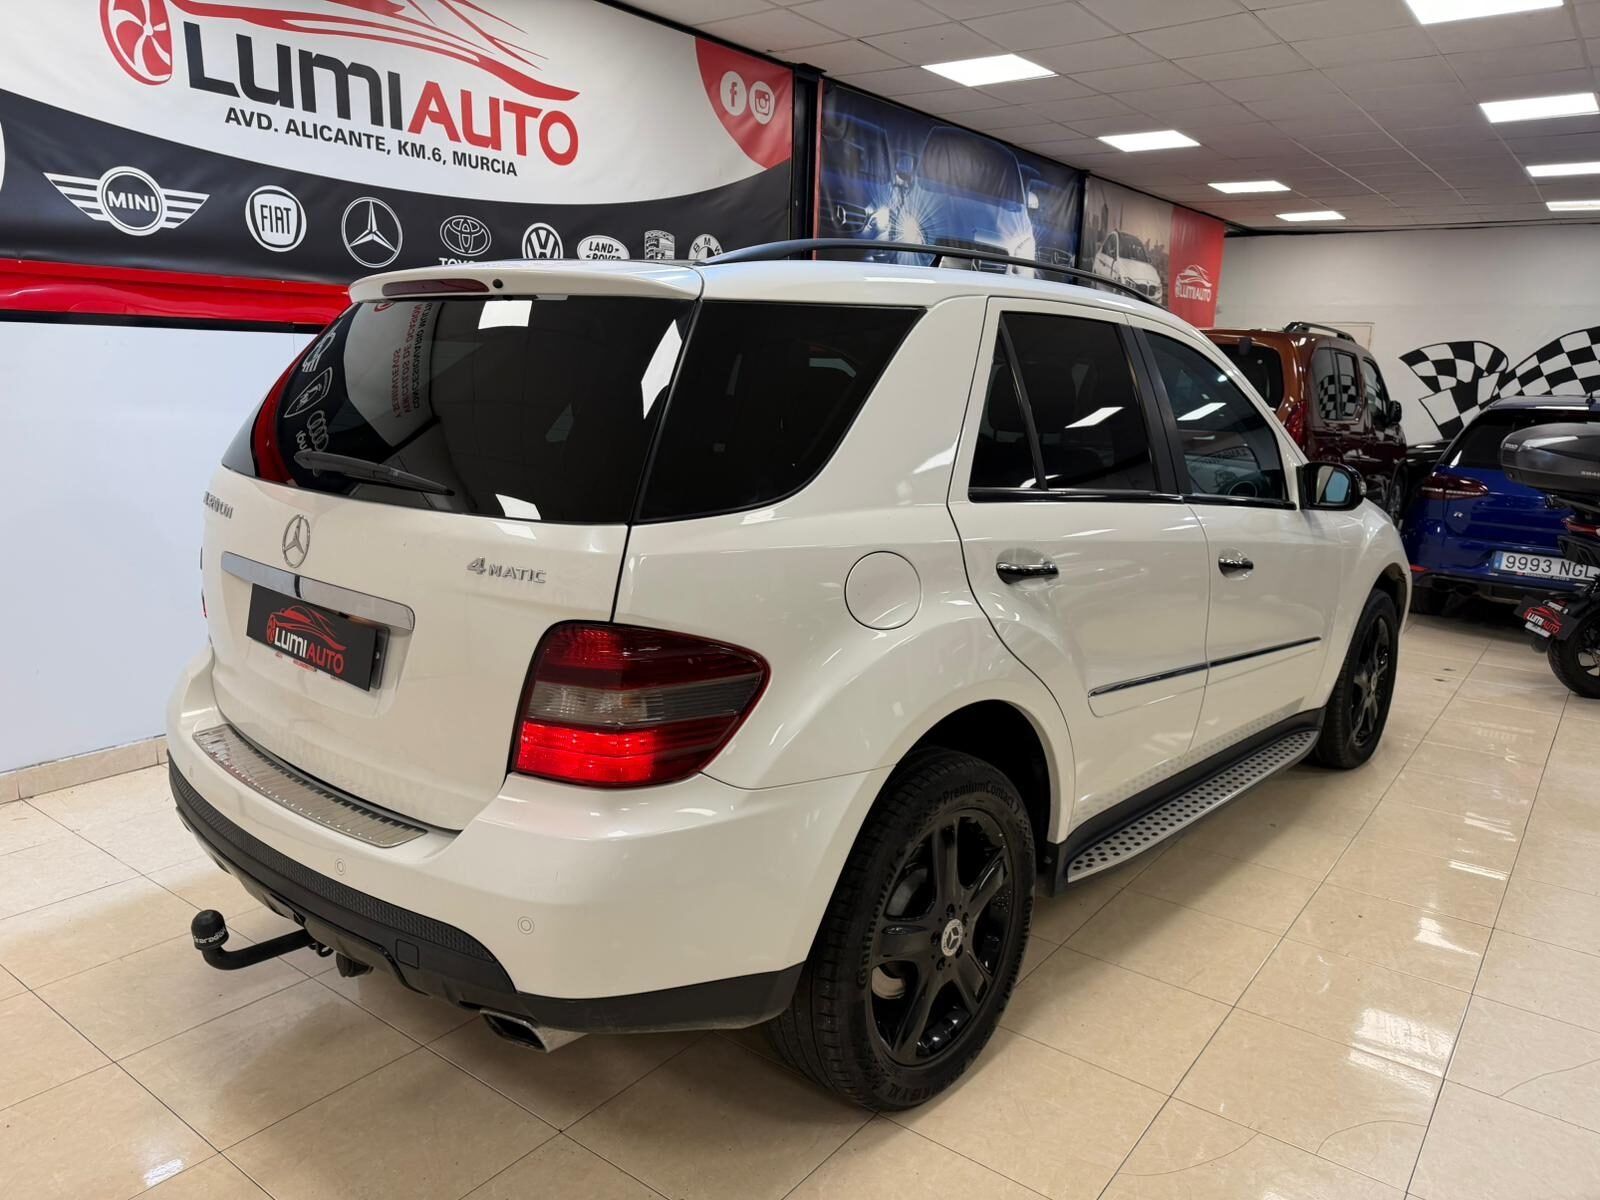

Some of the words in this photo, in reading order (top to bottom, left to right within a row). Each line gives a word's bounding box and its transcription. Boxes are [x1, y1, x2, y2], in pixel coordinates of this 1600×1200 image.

[225, 107, 278, 132] AVD.
[285, 119, 391, 155] ALICANTE,
[398, 140, 446, 165] KM.6,
[452, 151, 517, 176] MURCIA
[108, 191, 157, 212] MINI
[260, 204, 291, 234] FIAT
[1505, 555, 1553, 573] 9993
[1559, 561, 1595, 579] NGL
